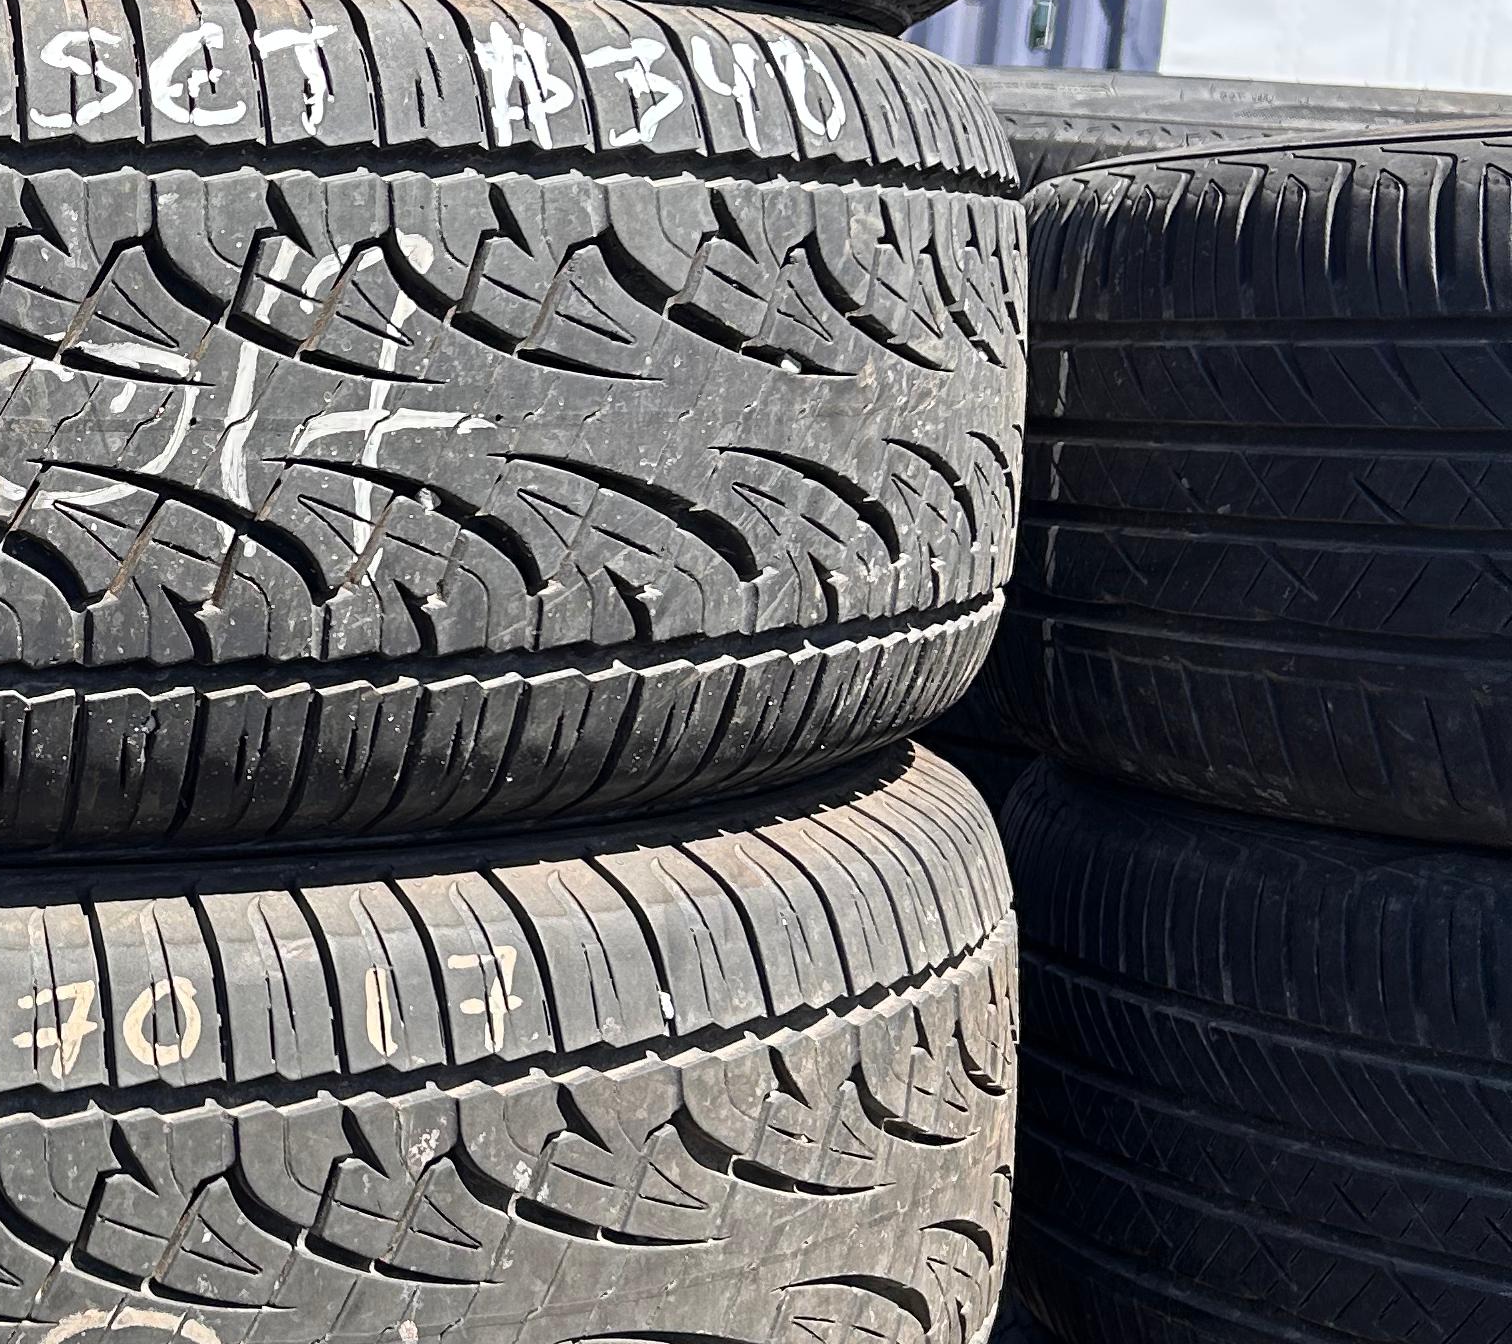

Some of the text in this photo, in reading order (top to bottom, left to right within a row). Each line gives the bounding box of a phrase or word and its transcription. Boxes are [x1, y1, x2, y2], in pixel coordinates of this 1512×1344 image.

[29, 22, 338, 137] SET
[12, 977, 199, 1082] 70
[363, 945, 524, 1058] 17
